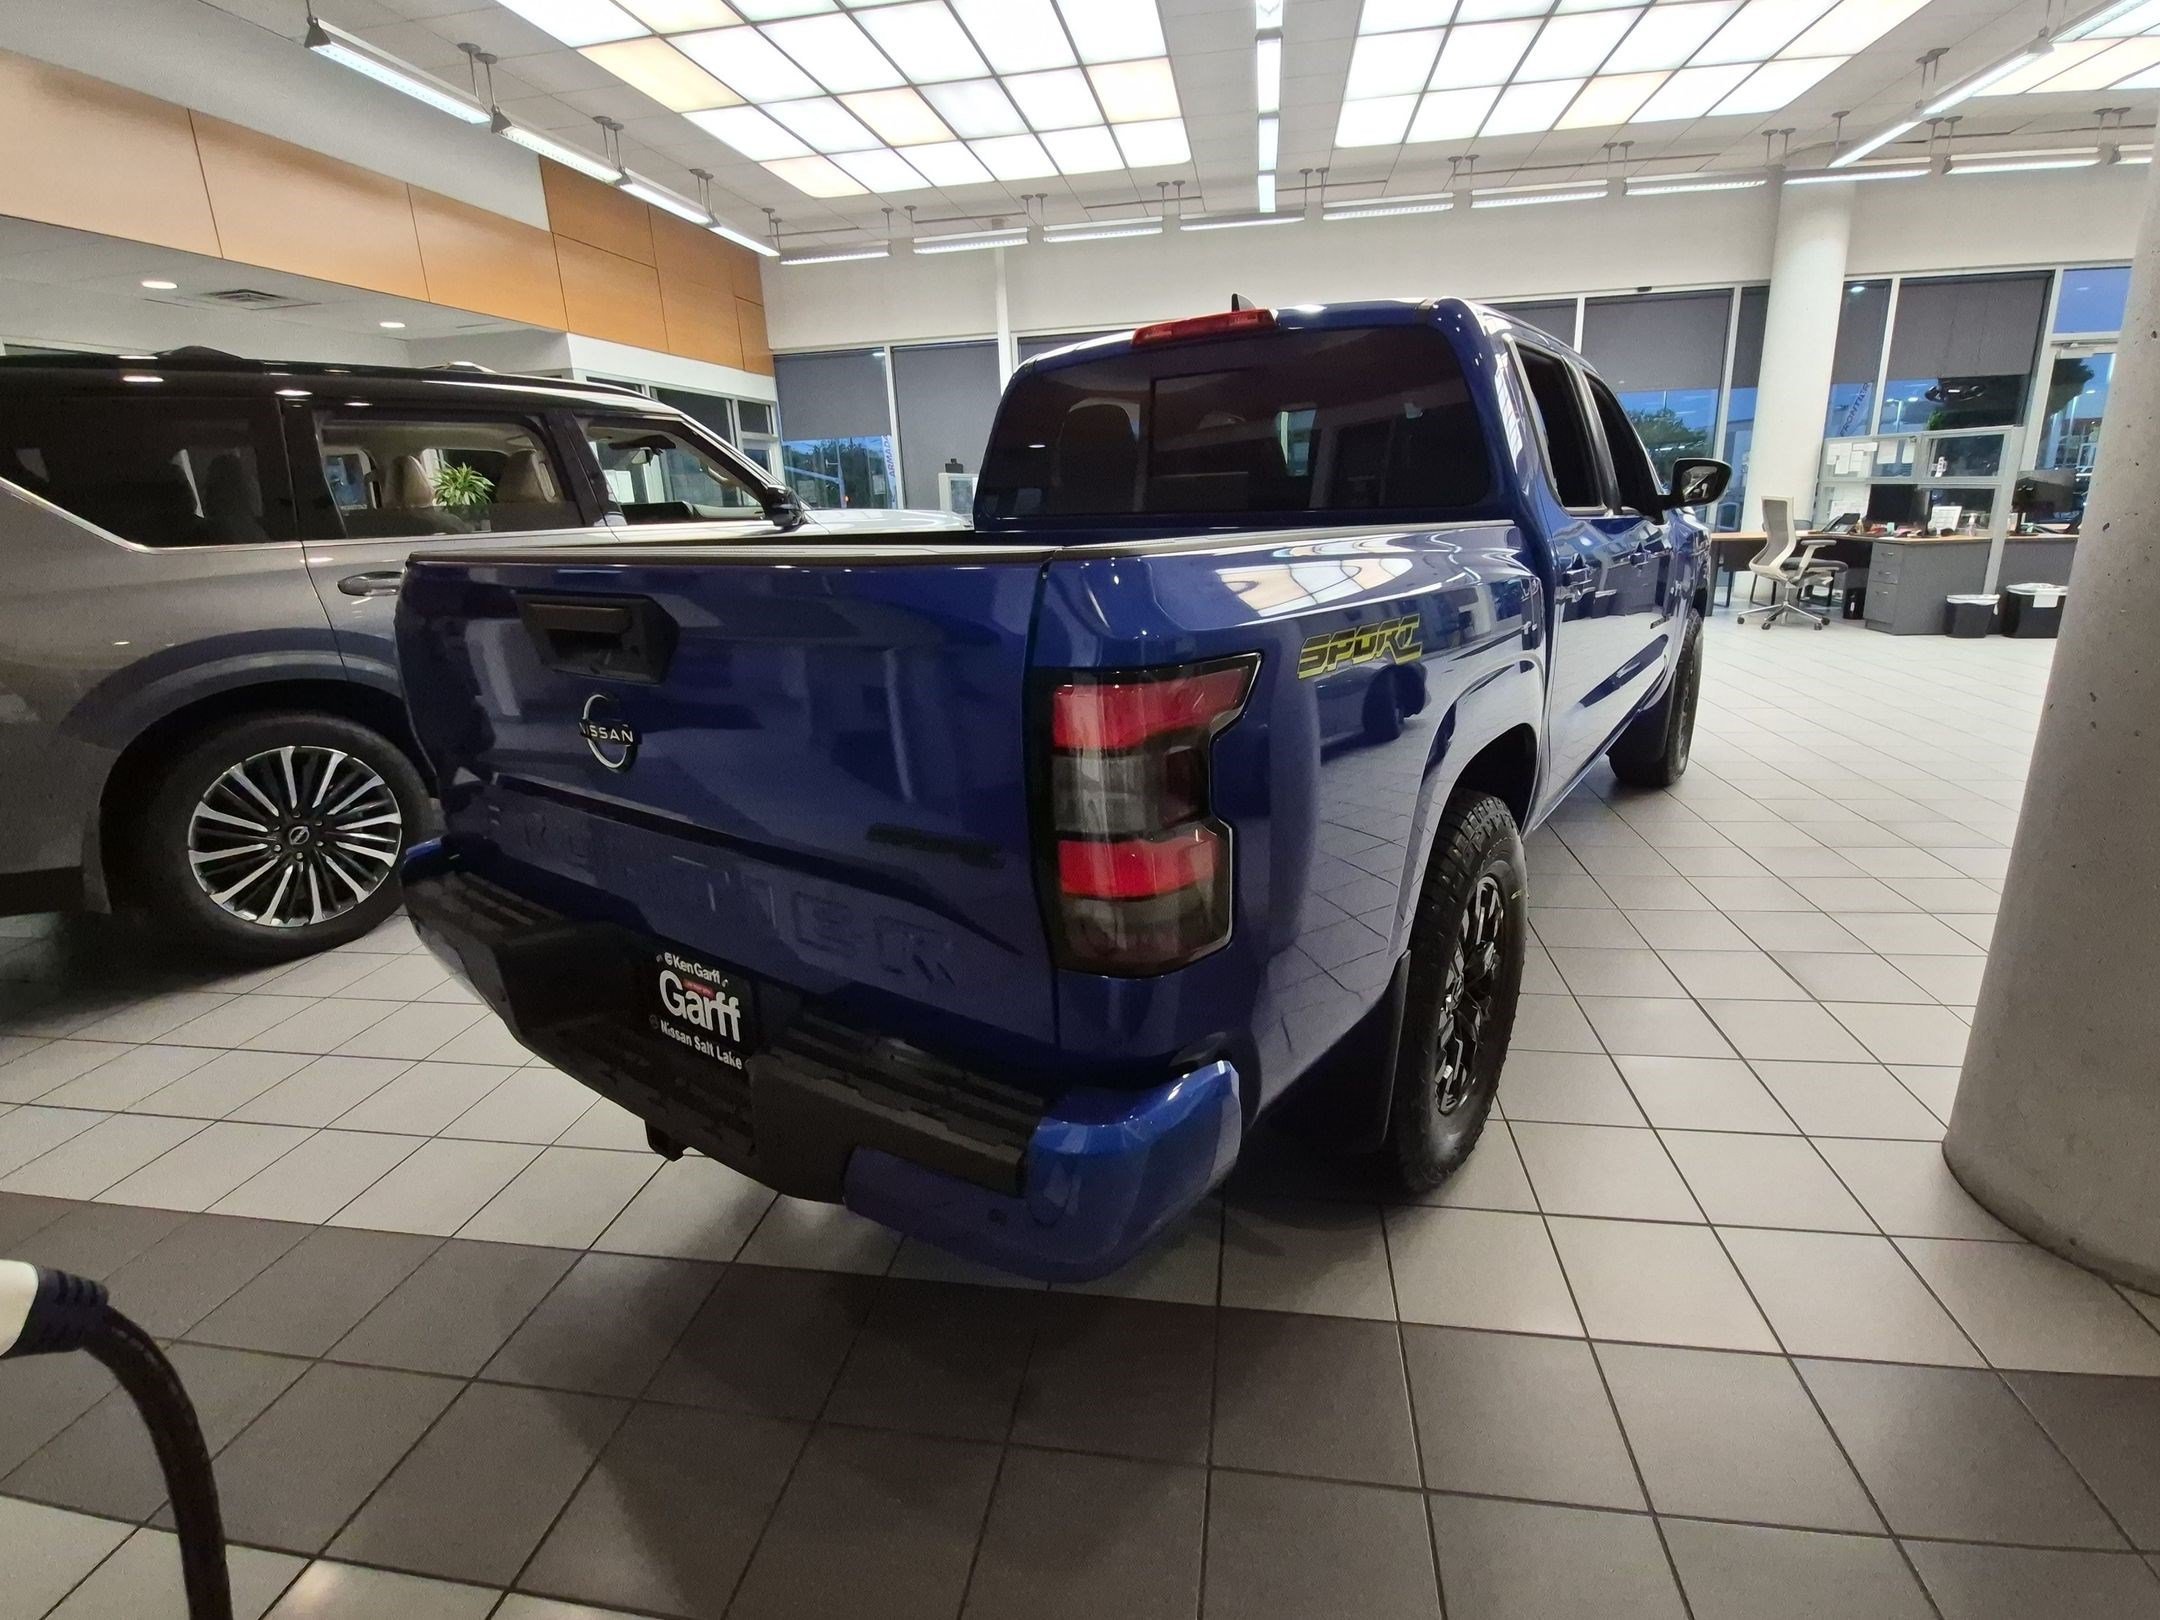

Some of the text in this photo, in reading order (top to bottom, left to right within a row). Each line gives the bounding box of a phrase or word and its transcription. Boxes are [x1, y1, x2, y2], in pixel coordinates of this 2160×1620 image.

[1839, 382, 1869, 437] FRONTIER
[694, 962, 721, 985] Garff
[659, 969, 741, 1042] Garff
[660, 1019, 742, 1070] Nissan Salt Lake
